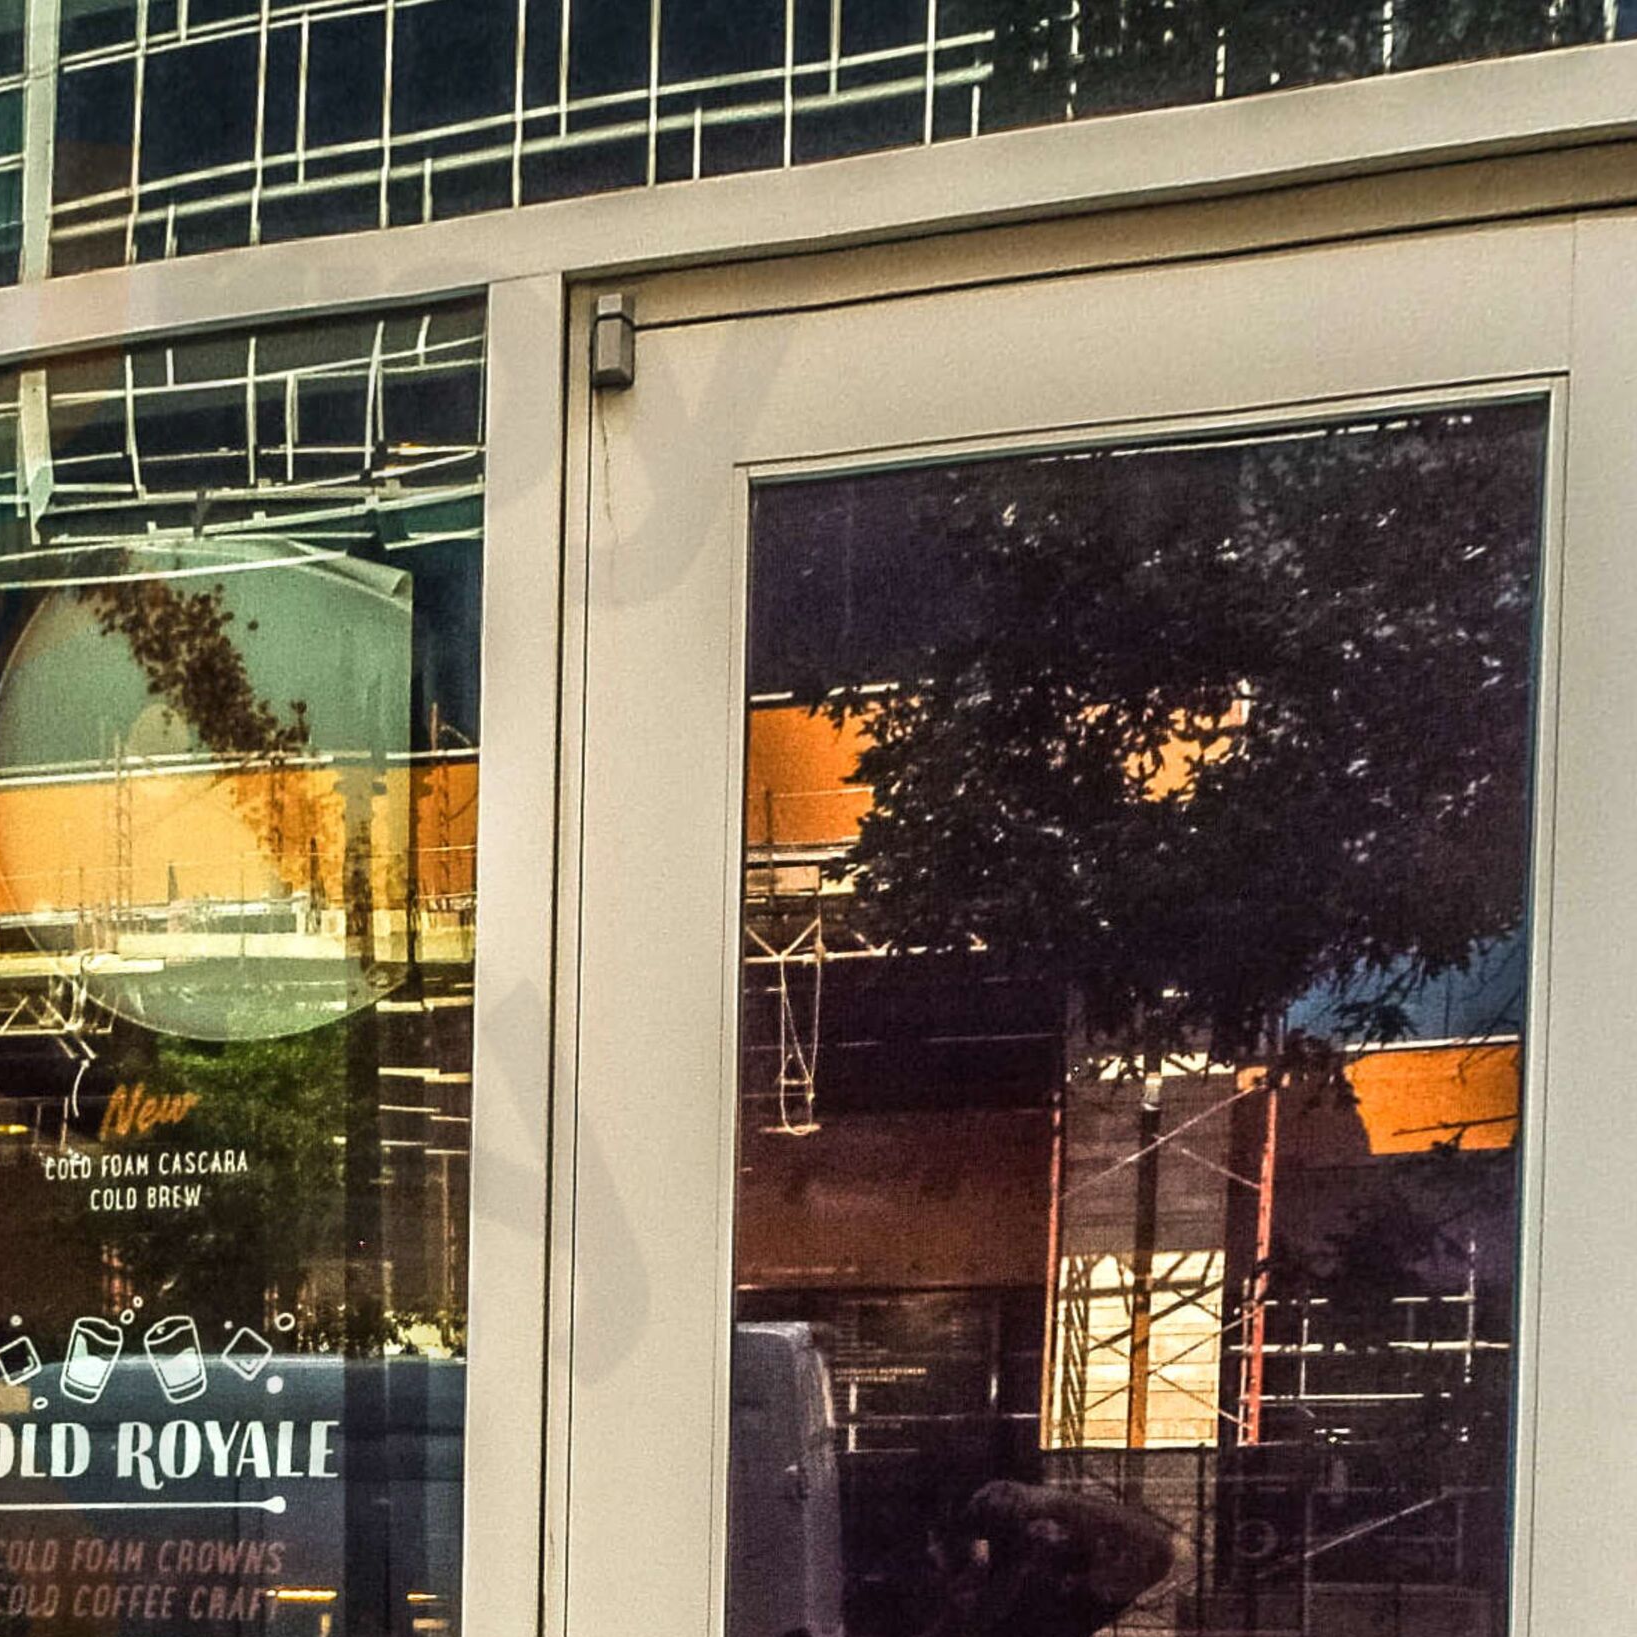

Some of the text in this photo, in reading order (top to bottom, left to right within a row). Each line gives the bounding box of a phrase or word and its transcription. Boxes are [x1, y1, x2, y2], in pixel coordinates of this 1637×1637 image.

[101, 1084, 199, 1140] New
[45, 1149, 249, 1181] COLD FOAM CASCARA
[90, 1184, 203, 1211] COLD BREW
[117, 1419, 340, 1490] ROYALE
[71, 1539, 144, 1575] FOAM
[158, 1539, 285, 1576] CROWNS
[72, 1584, 176, 1620] COFFEE
[186, 1585, 284, 1621] CRAFT
